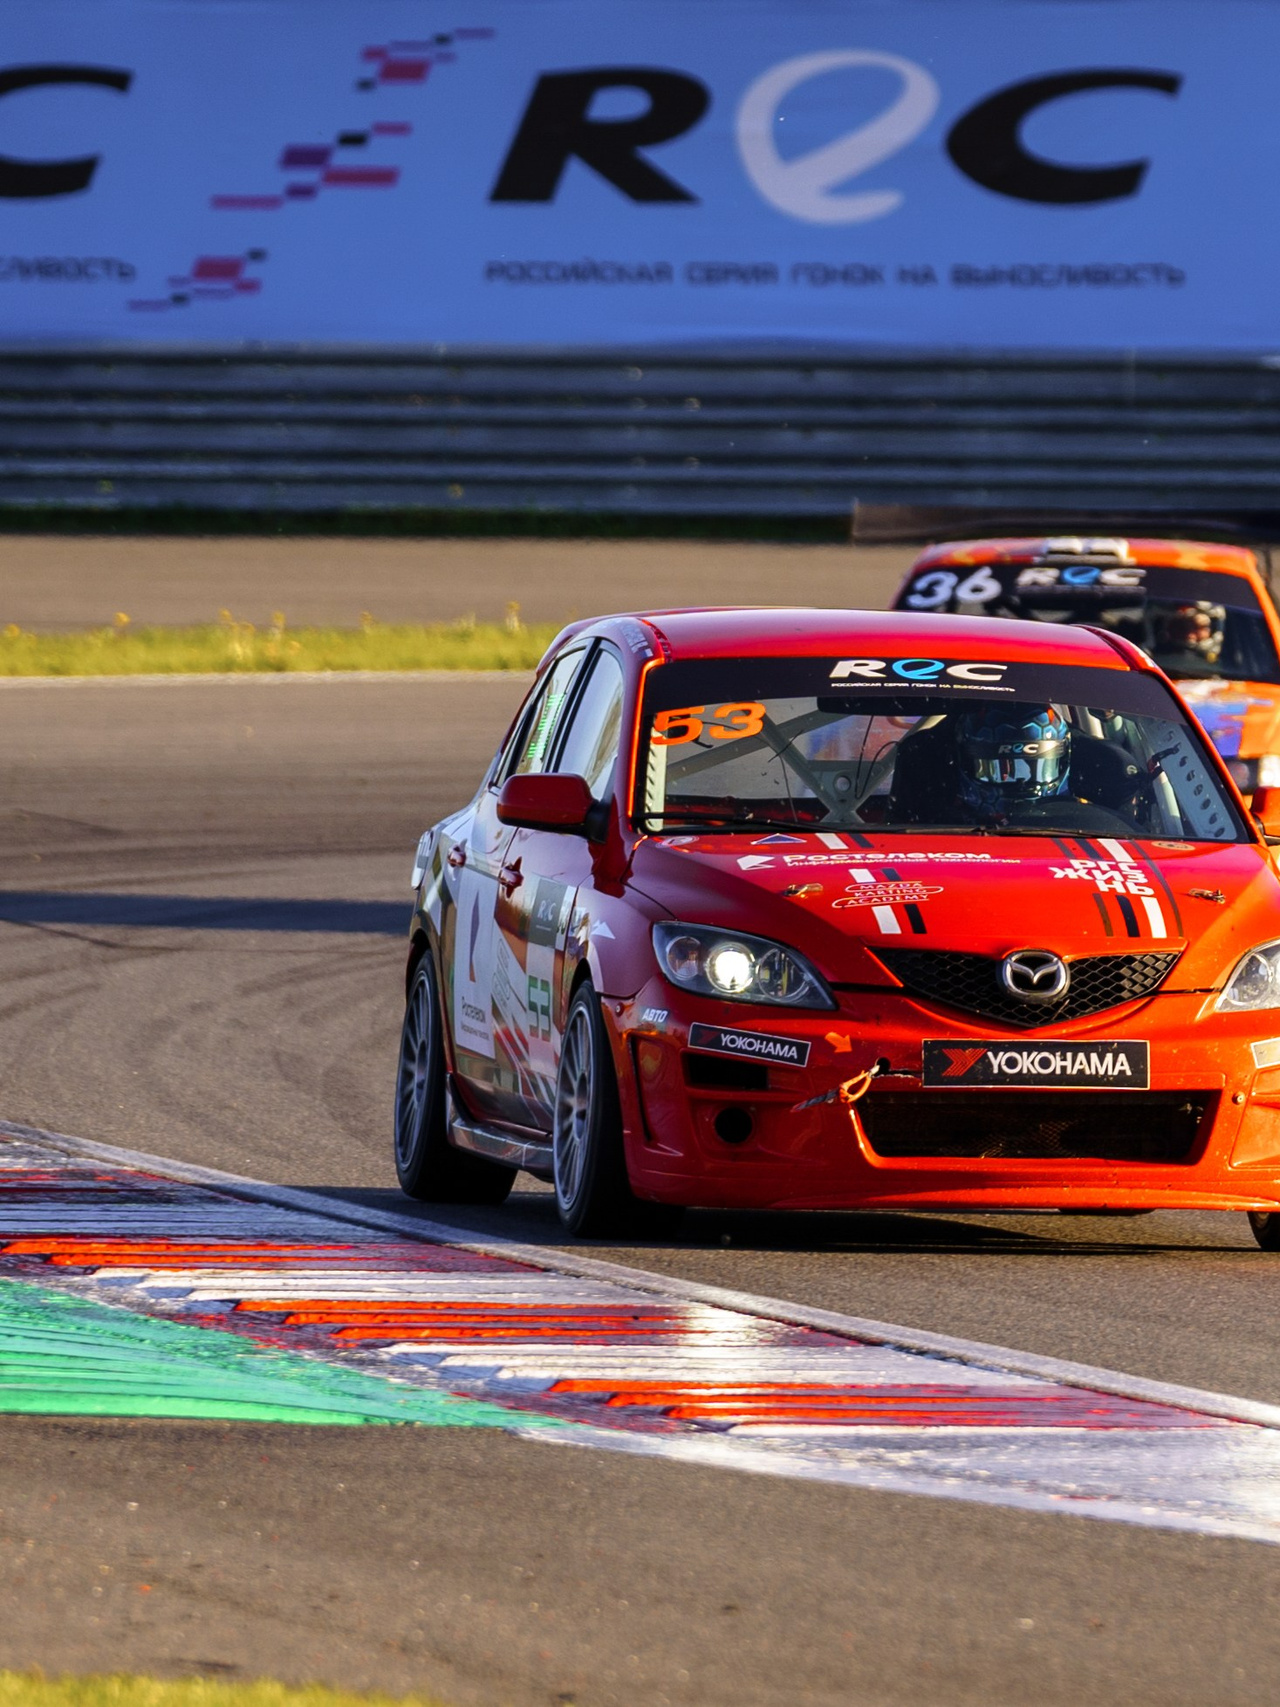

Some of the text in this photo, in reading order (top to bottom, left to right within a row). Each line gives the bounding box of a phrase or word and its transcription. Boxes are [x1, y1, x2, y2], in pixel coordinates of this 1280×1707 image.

[484, 257, 674, 284] РОССИЙСКАЯ
[684, 260, 779, 287] СЕРИЯ
[790, 261, 886, 288] ГОНОК
[896, 262, 938, 287] НА
[907, 566, 1002, 608] 36
[650, 702, 767, 746] 53
[720, 1033, 798, 1060] YOKOHAMA
[987, 1051, 1132, 1076] YOKOHAMA
